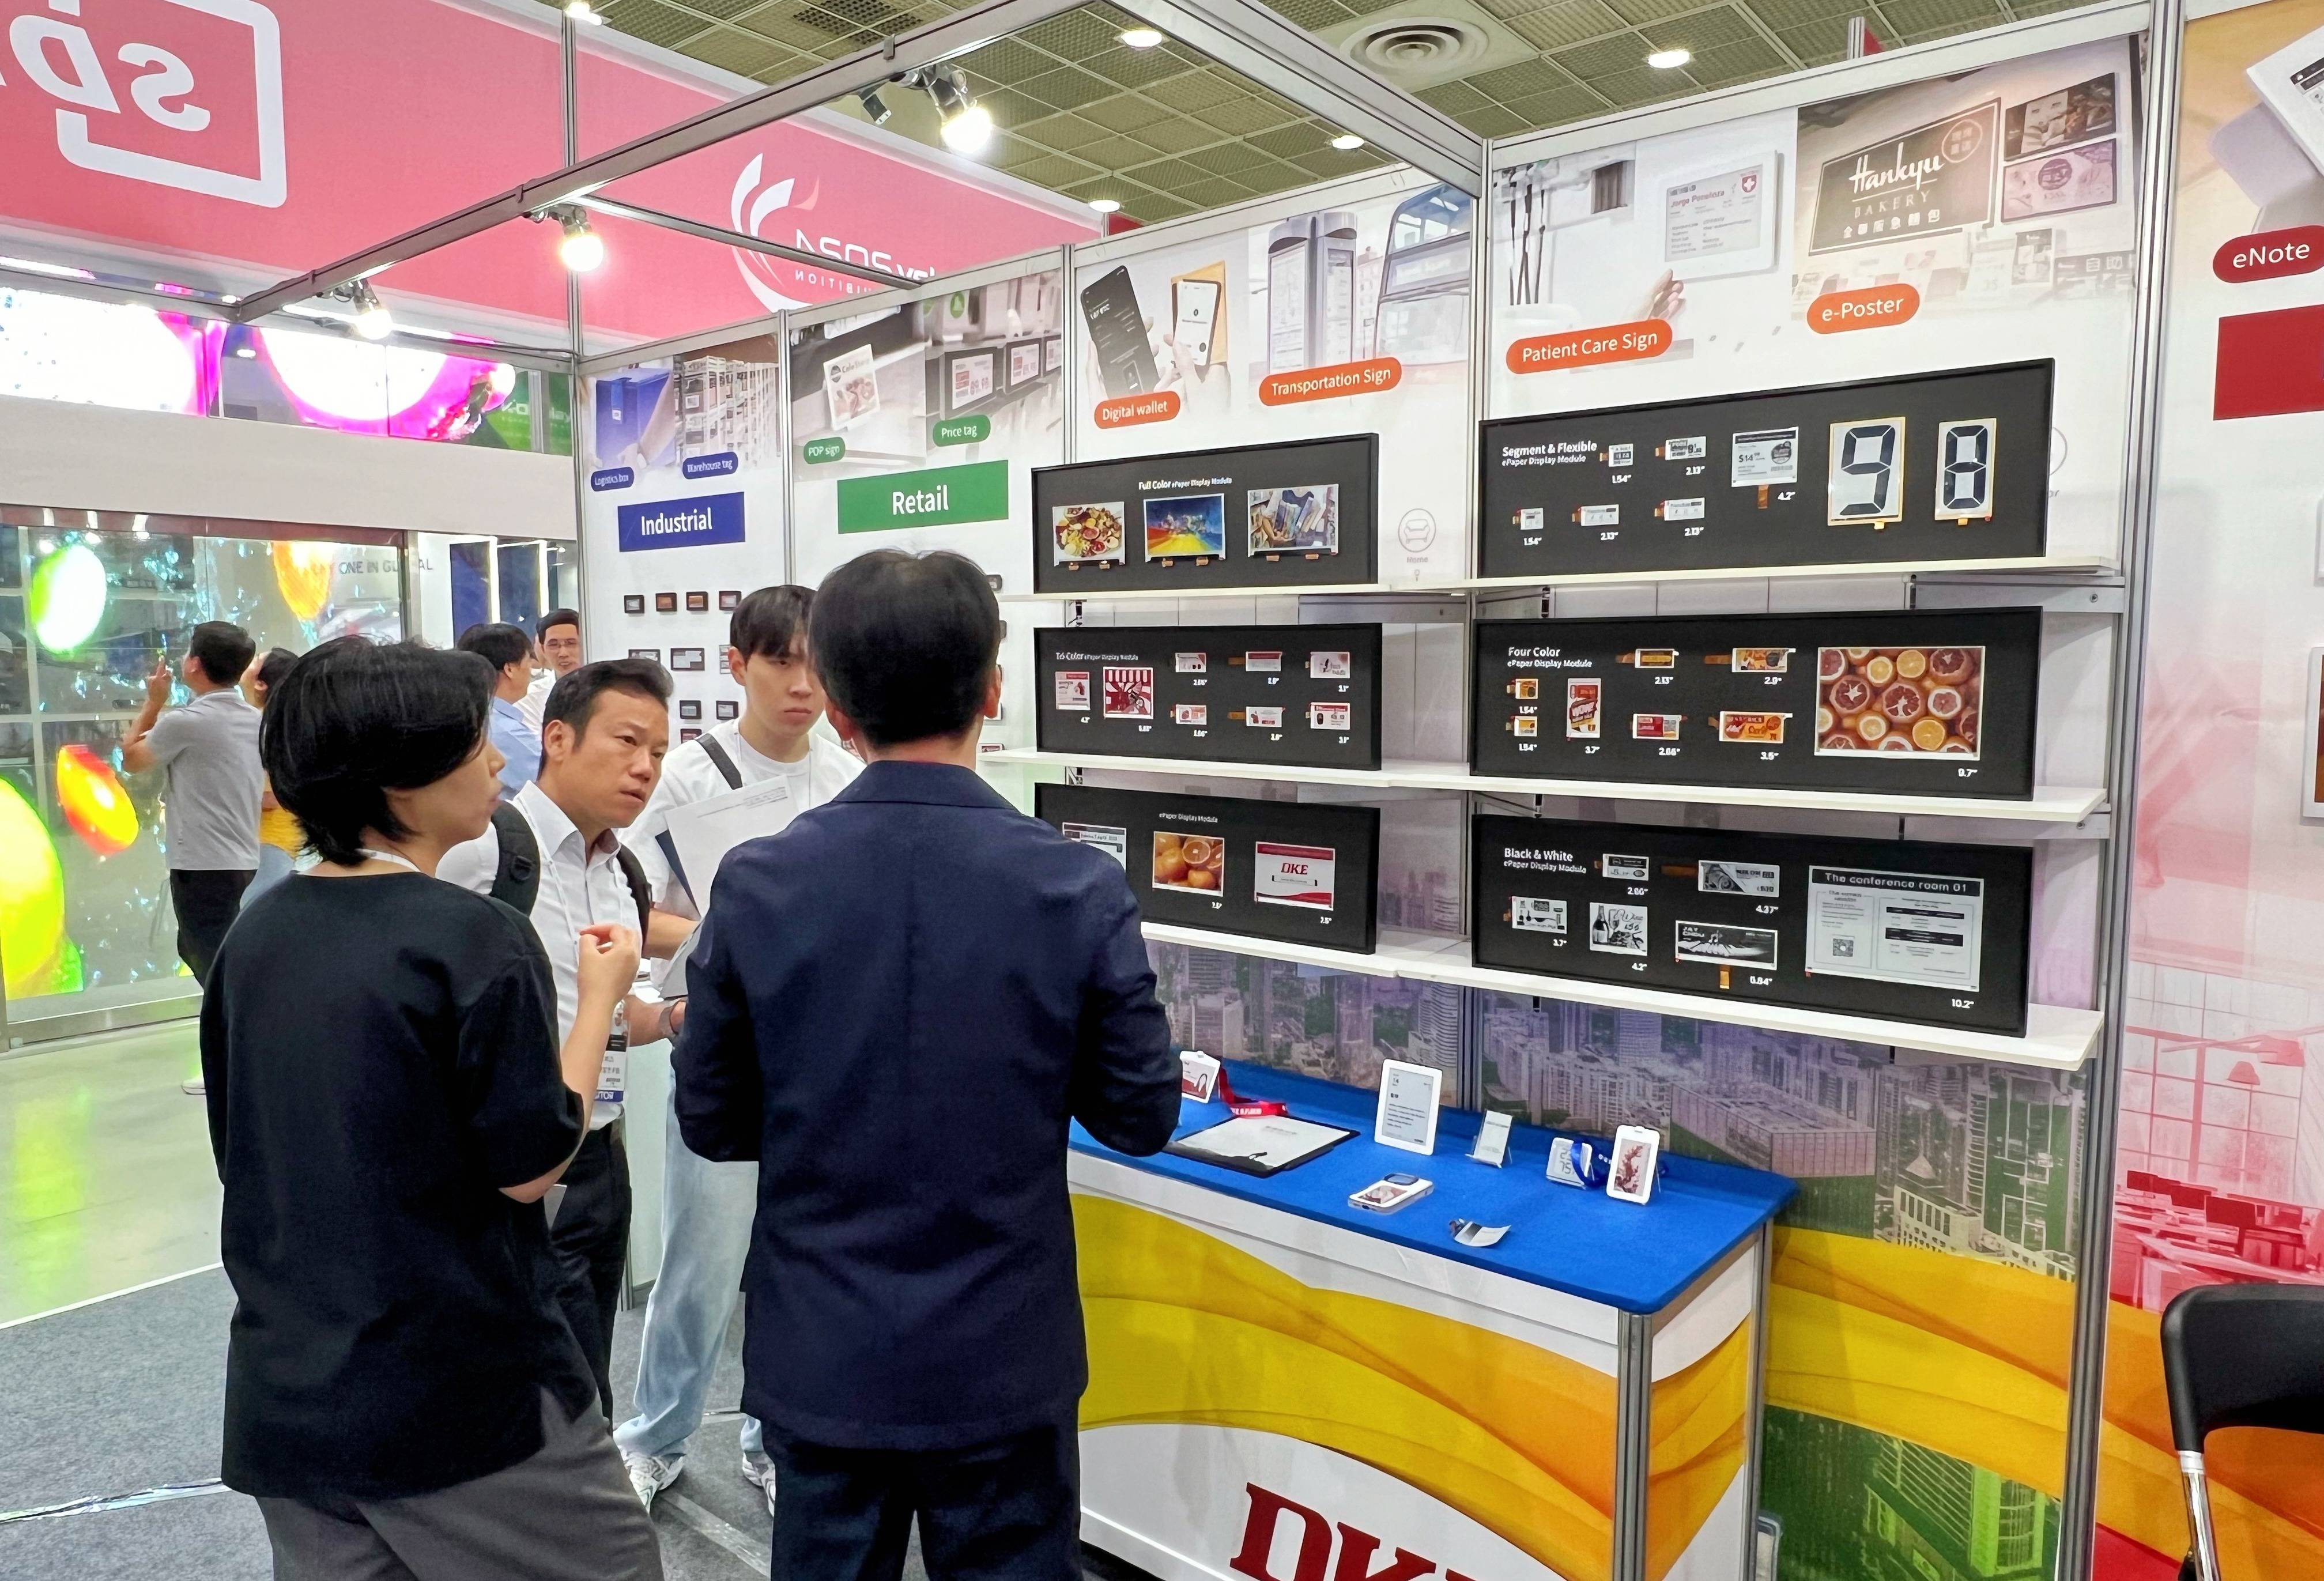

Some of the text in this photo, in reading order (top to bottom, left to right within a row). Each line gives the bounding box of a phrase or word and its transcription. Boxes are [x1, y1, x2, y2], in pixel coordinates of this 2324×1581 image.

[1848, 142, 1945, 194] Hankyu
[2232, 242, 2311, 270] eNote
[1821, 297, 1904, 322] e-Poster
[1522, 331, 1658, 363] Patient Care Sign
[1271, 367, 1391, 396] Transportation Sign
[1102, 400, 1168, 422] Digital wallet
[941, 425, 978, 439] Price tag
[808, 446, 825, 457] POP
[1502, 440, 1597, 458] Segment & Flexible
[1529, 456, 1556, 466] Display
[1557, 454, 1586, 464] Module
[1944, 424, 1989, 510] 8
[1139, 481, 1152, 490] Full
[1152, 479, 1171, 490] Color
[892, 484, 949, 515] Retail
[641, 507, 713, 535] Industrial
[1508, 647, 1560, 657] Four Color
[1534, 659, 1561, 669] Display
[1504, 848, 1574, 862] Black & White
[1280, 862, 1308, 875] DKE
[1530, 861, 1557, 872] Display
[1559, 863, 1587, 874] Module
[1824, 872, 1967, 893] The conference room 01
